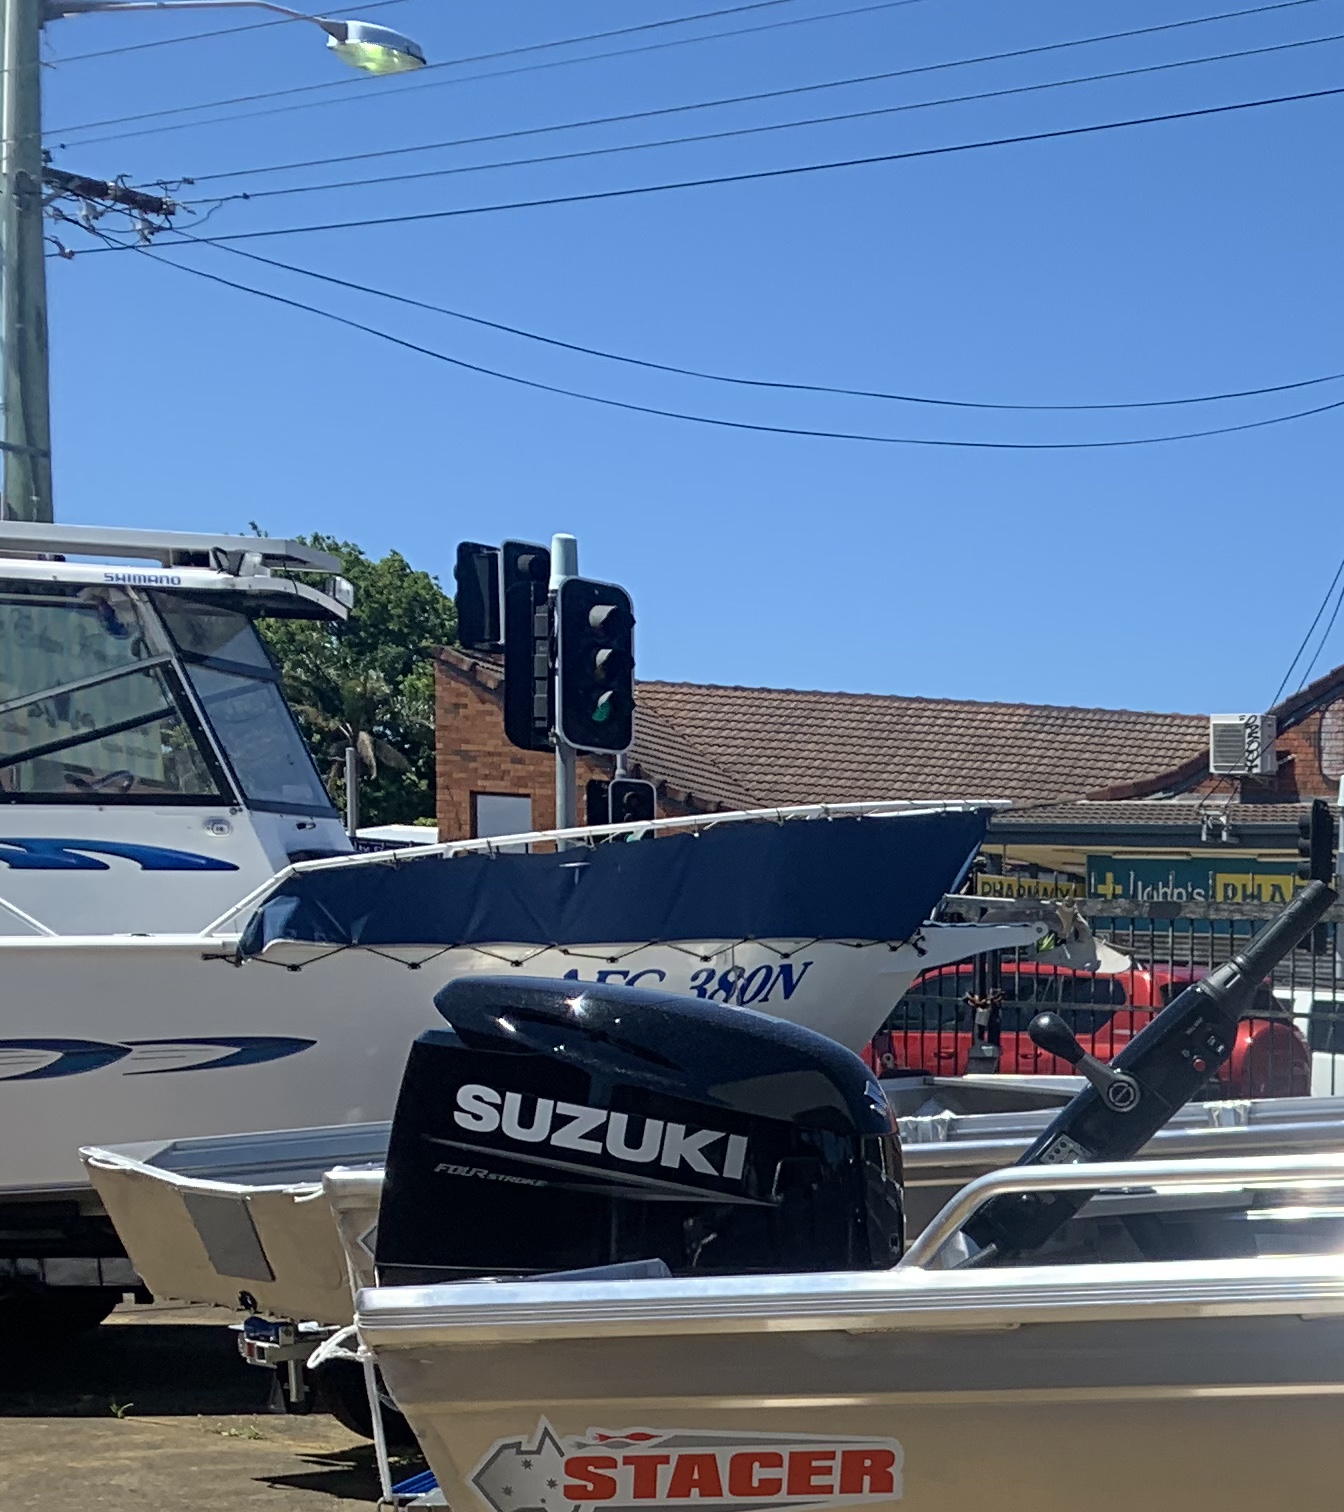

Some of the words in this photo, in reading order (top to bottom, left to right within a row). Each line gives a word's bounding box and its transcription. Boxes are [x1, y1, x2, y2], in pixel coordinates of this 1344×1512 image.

[104, 572, 181, 586] SHIMANO
[453, 1083, 749, 1180] SUZUKI
[562, 1448, 896, 1501] STACER
